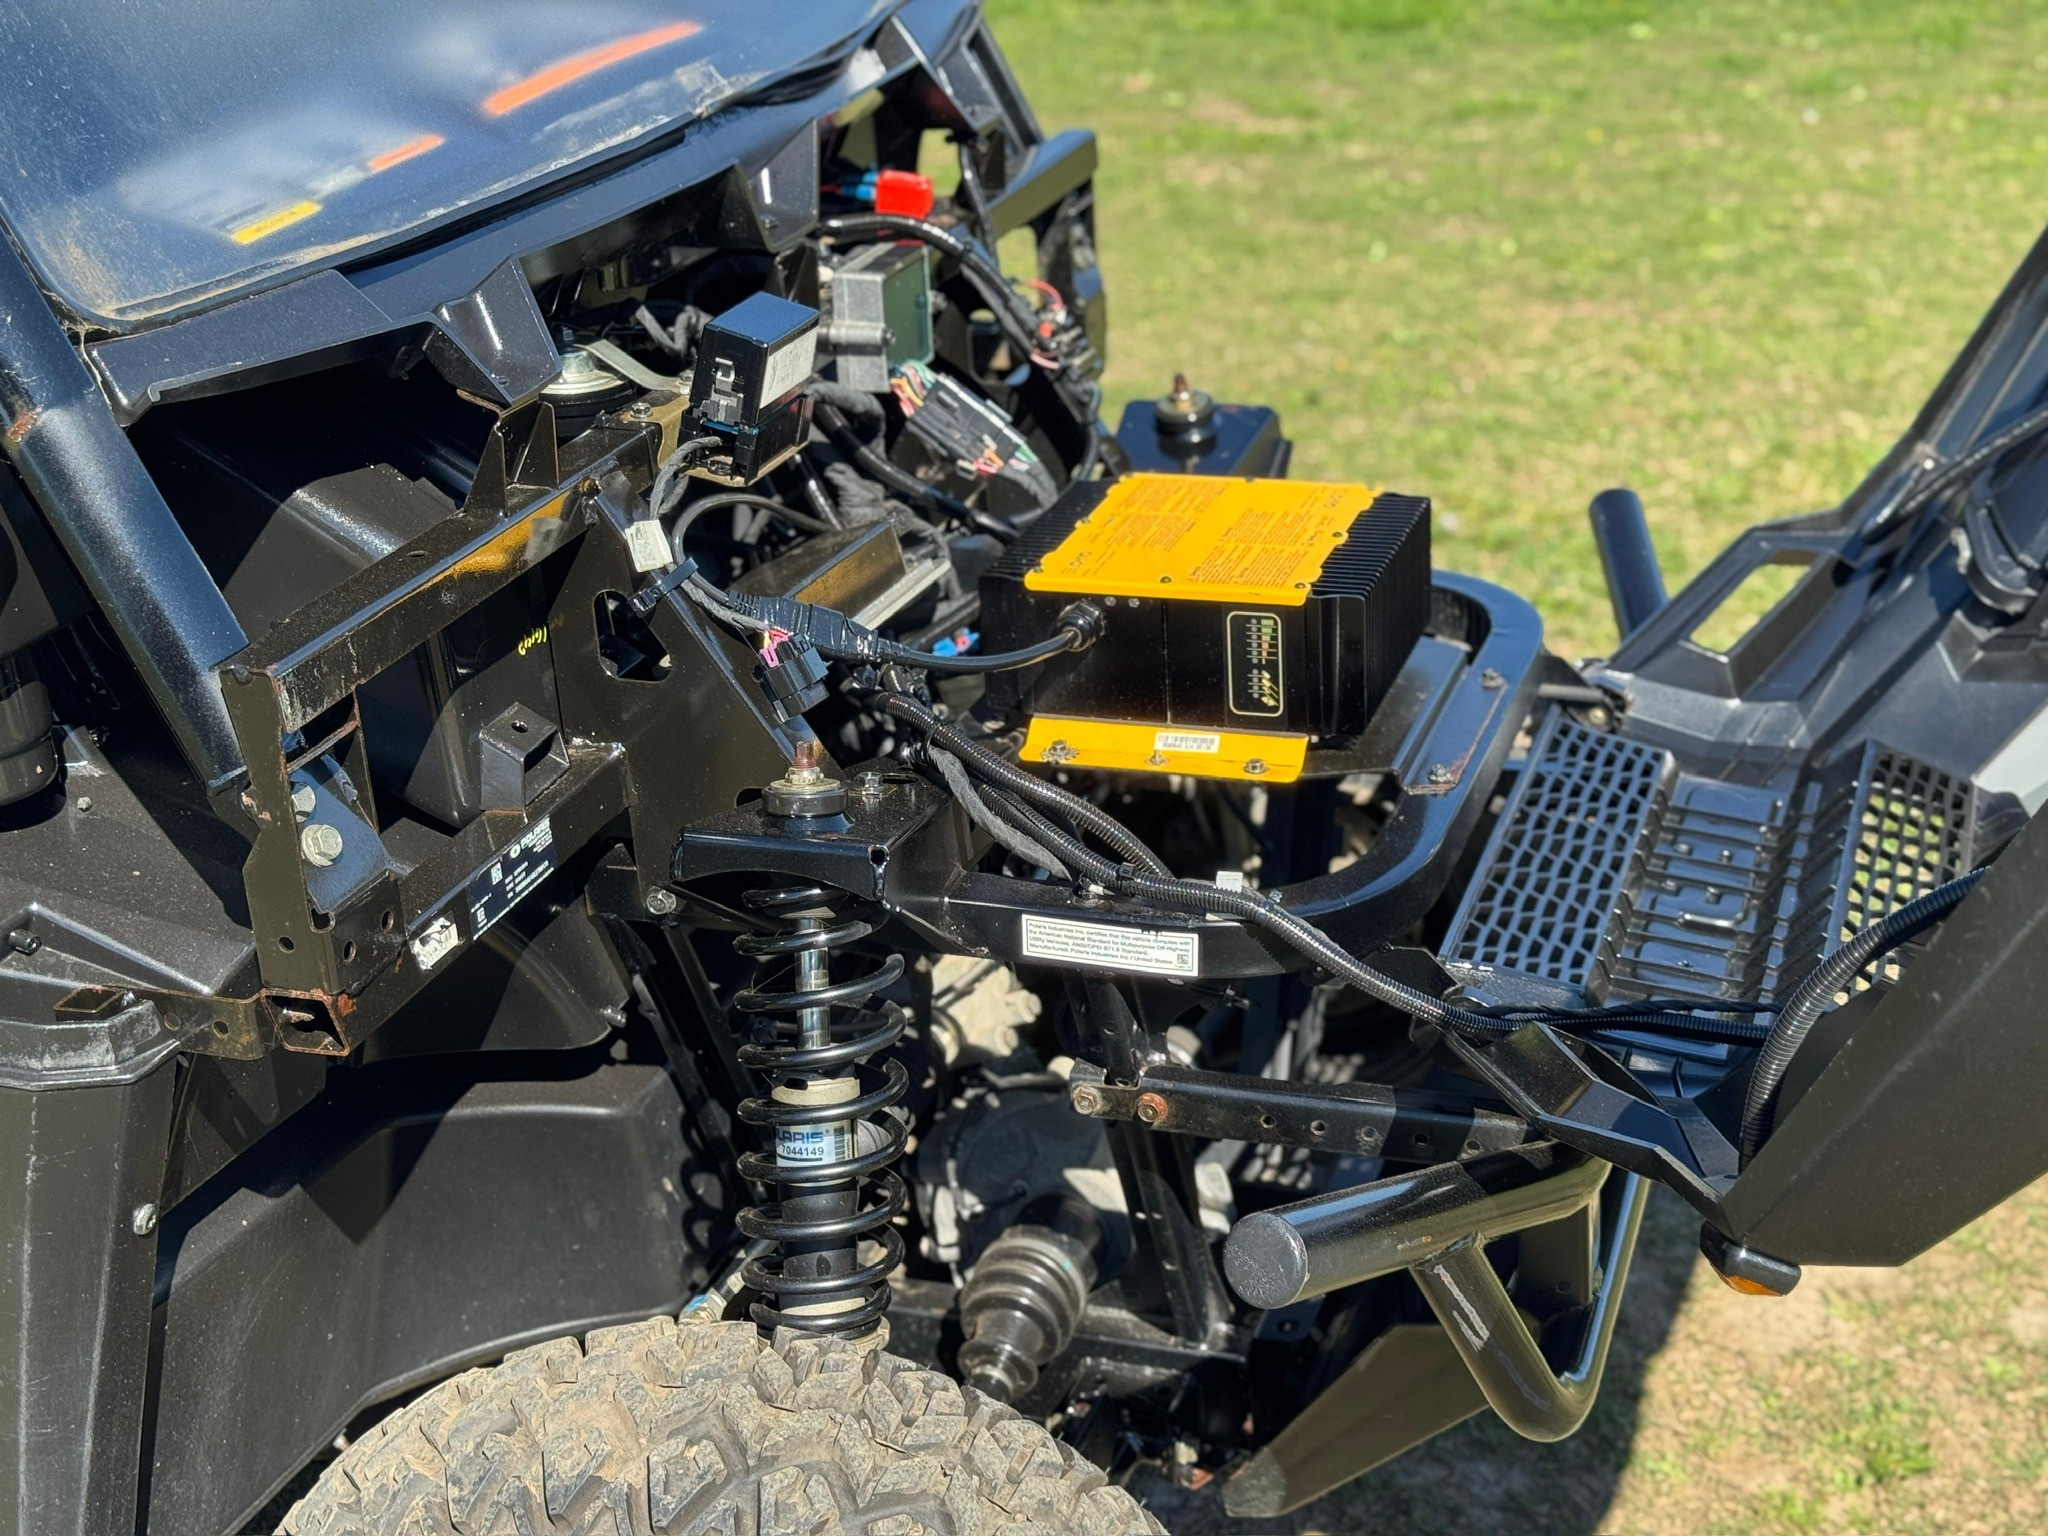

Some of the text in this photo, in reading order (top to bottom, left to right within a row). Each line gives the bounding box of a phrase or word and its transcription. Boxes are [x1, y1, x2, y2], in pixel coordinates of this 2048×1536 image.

[1120, 941, 1155, 950] Multipurpose
[777, 1129, 824, 1144] LARIS
[781, 1144, 824, 1156] 7044149
